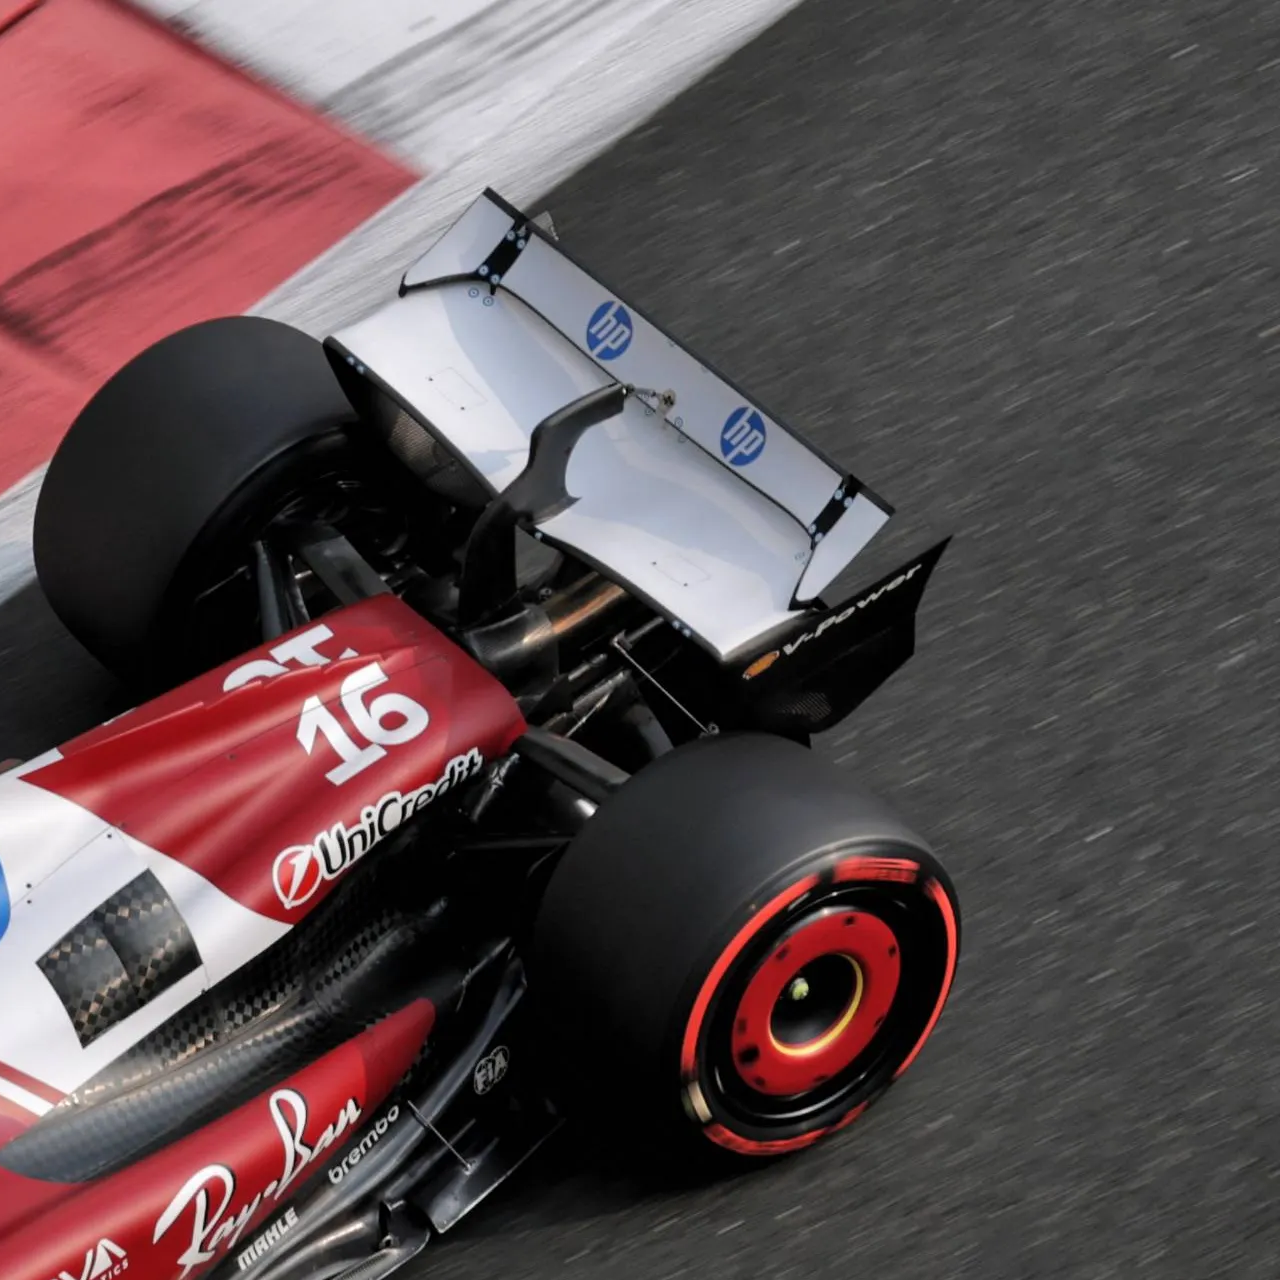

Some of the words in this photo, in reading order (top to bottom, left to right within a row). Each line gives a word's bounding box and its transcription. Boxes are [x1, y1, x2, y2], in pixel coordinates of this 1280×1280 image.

[587, 301, 633, 360] hp
[721, 406, 766, 465] hp
[296, 661, 430, 787] 16
[314, 747, 483, 881] UniCredit
[476, 1049, 509, 1094] FIA
[328, 1105, 400, 1184] brembo
[152, 1088, 362, 1280] Ray-Ban
[238, 1207, 301, 1270] MAHLE
